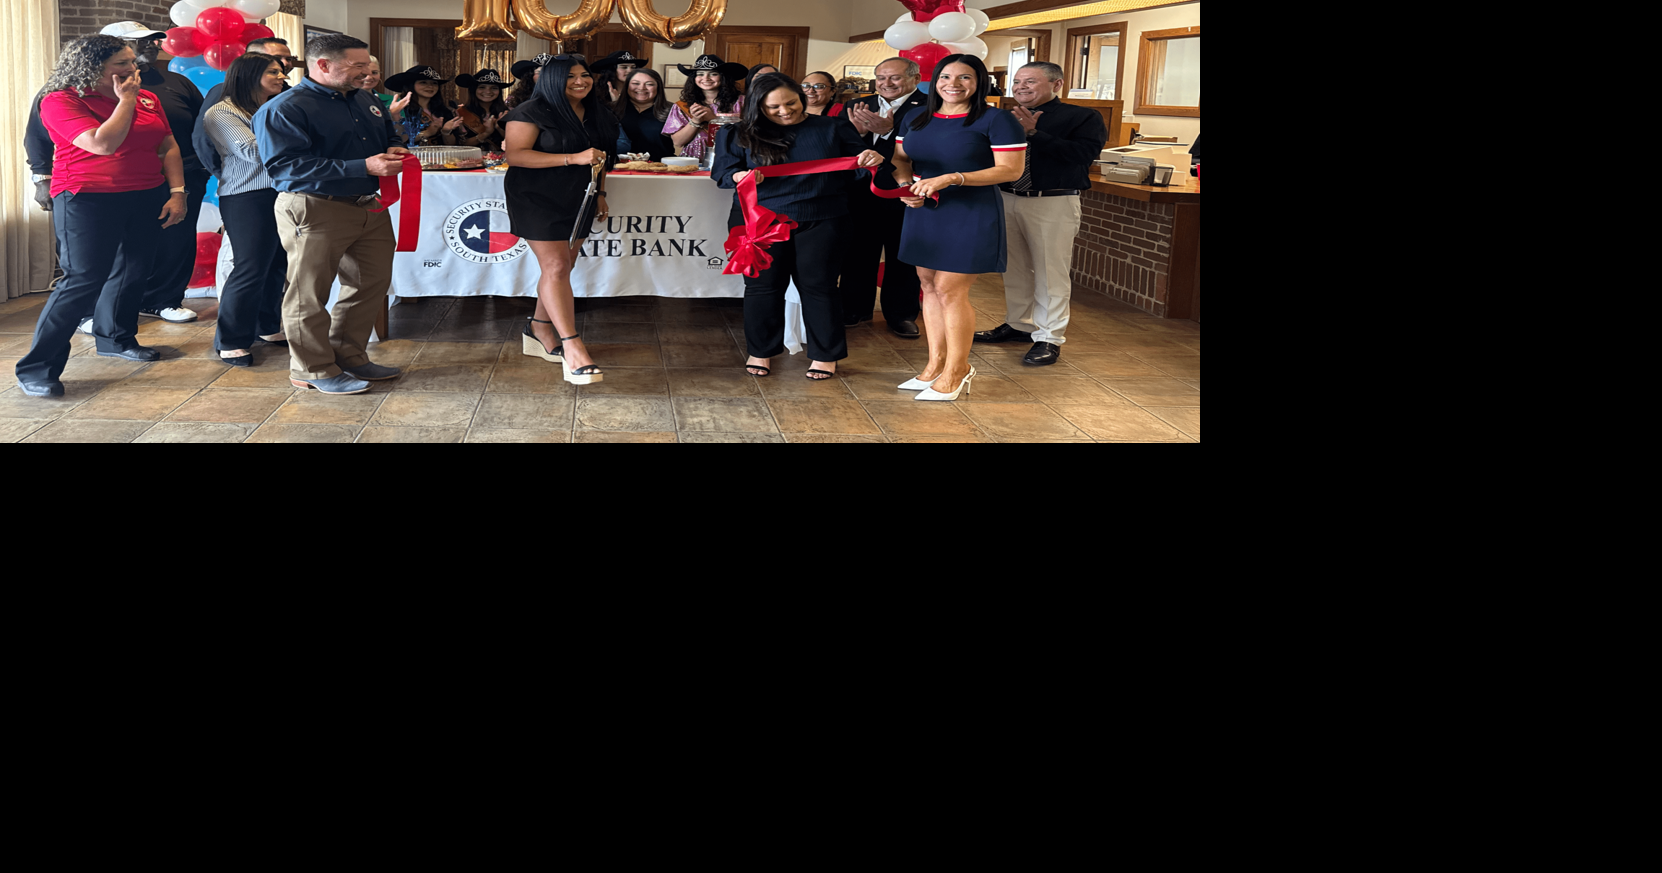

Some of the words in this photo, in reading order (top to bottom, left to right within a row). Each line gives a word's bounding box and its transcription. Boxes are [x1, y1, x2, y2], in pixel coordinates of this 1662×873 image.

[446, 202, 482, 234] SECURITY
[485, 200, 506, 210] STA
[451, 241, 488, 262] SOUTH
[491, 243, 528, 262] TEXAS
[630, 239, 708, 257] BANK
